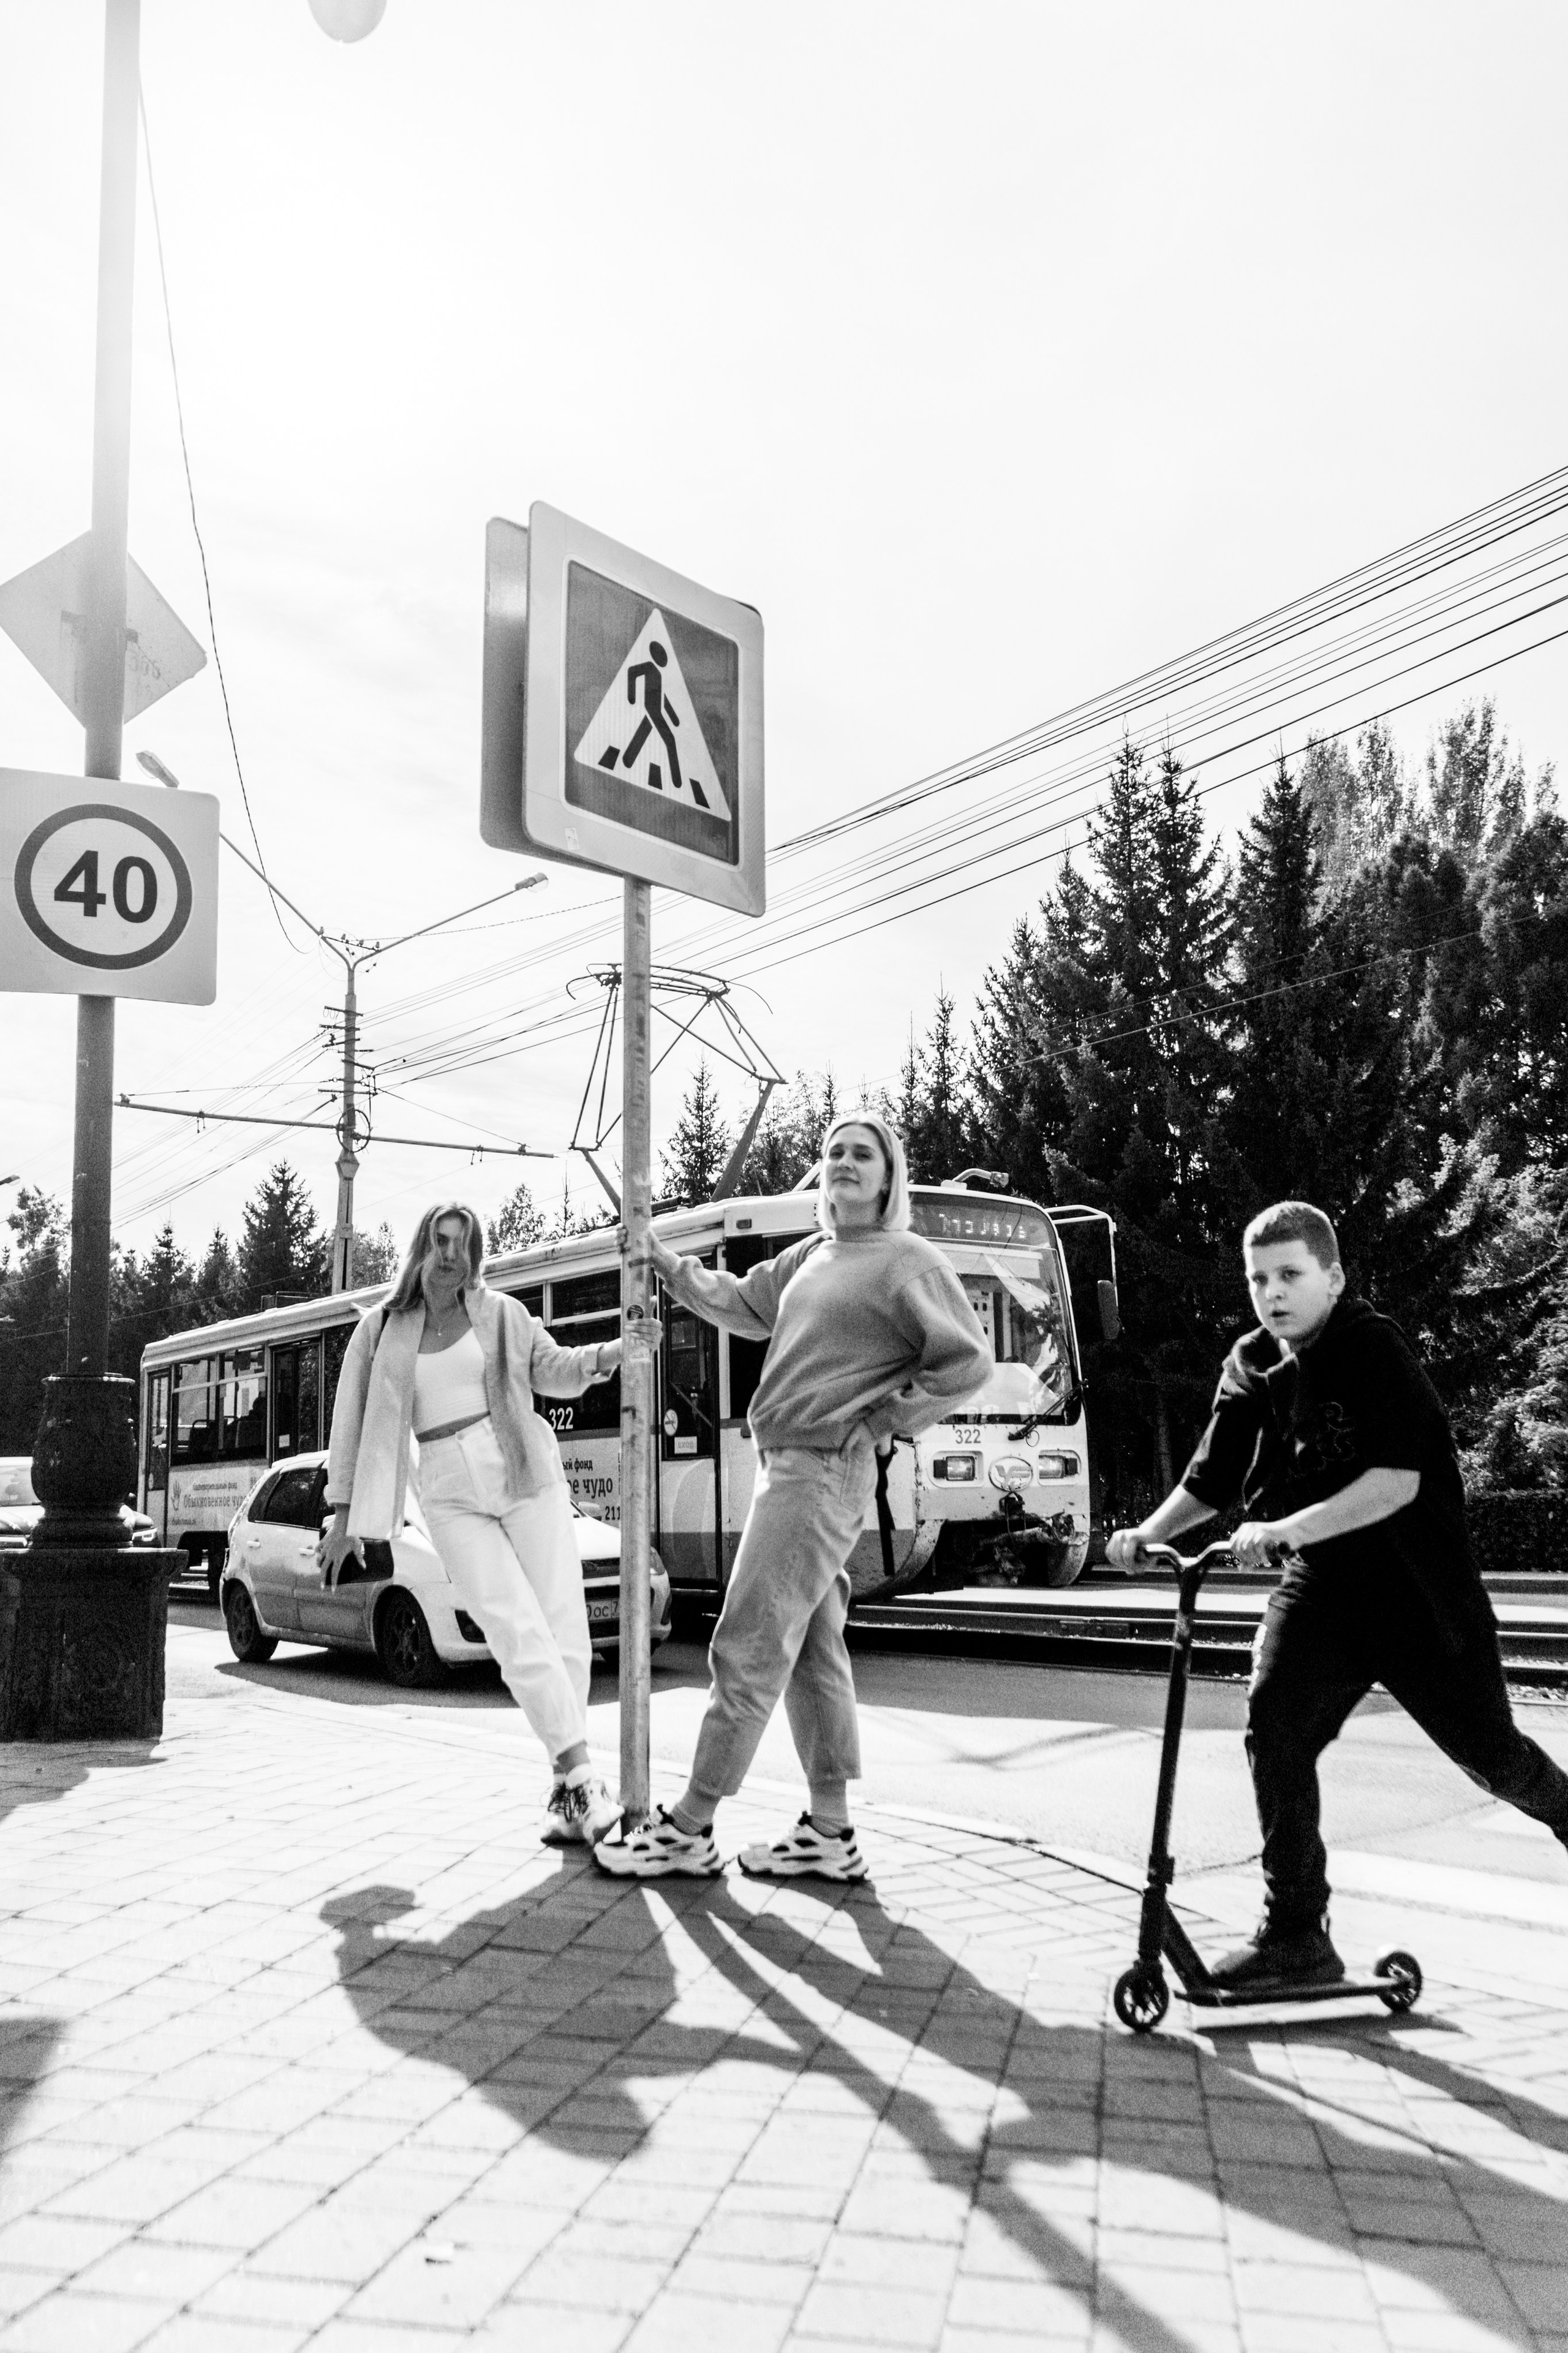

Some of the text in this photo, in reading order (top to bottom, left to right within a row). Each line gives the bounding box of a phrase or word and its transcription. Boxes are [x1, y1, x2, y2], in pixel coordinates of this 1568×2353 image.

[55, 850, 157, 923] 40
[549, 1407, 573, 1430] 322
[955, 1429, 981, 1444] 322
[574, 1457, 593, 1473] фонд
[582, 1478, 613, 1499] чудо
[184, 1494, 230, 1508] Обыкновенное
[605, 1506, 620, 1520] 211
